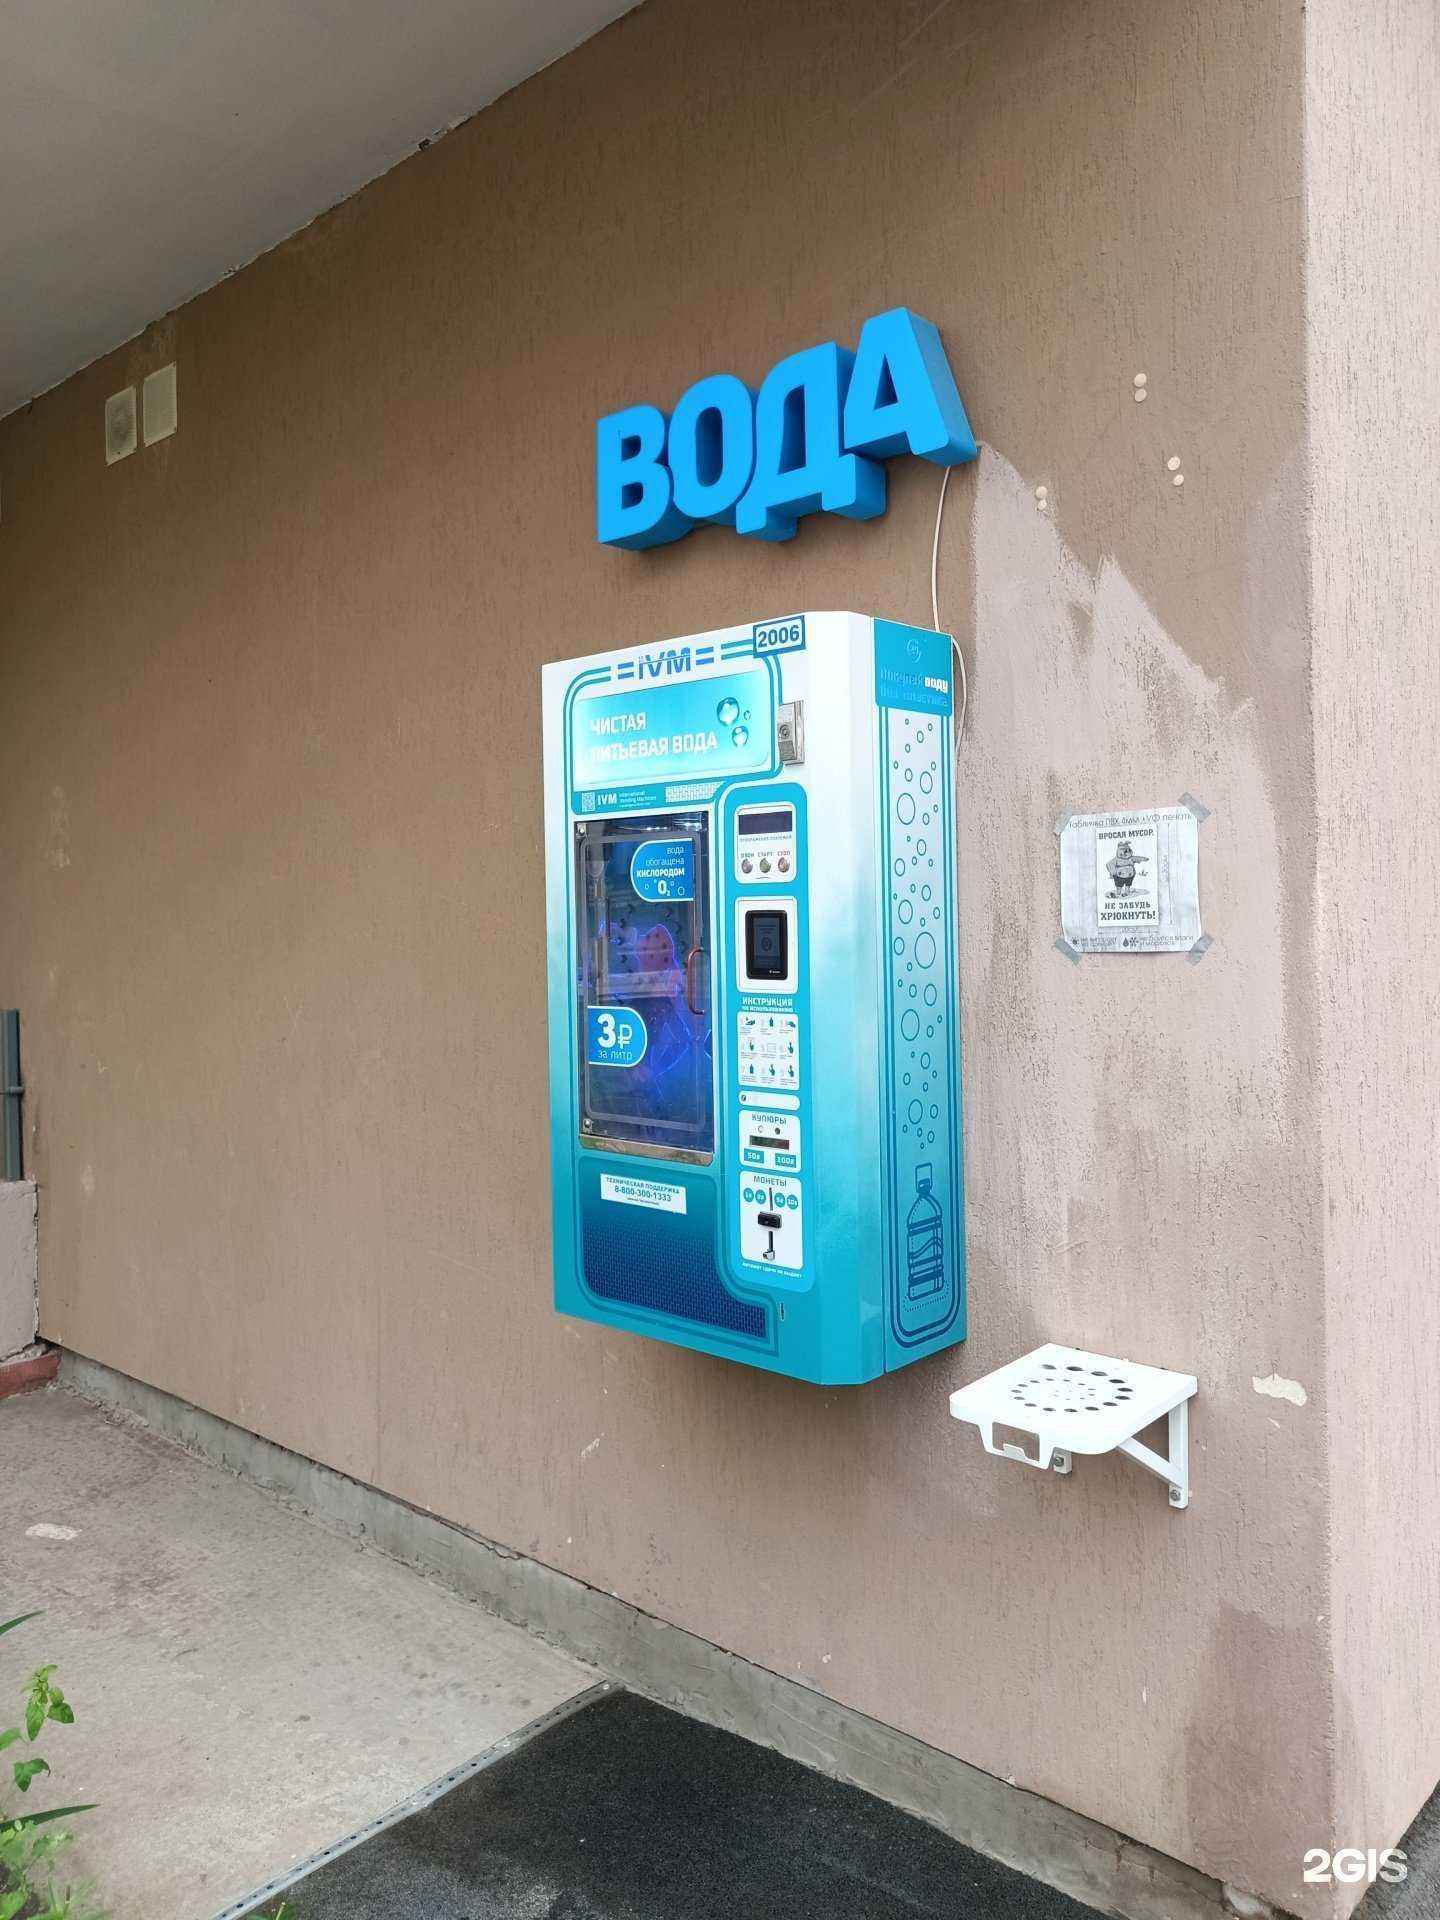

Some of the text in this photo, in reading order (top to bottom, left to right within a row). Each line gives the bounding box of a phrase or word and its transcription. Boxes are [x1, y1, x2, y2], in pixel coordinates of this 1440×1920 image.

[595, 306, 966, 541] ВОДА
[757, 624, 800, 648] 2006
[591, 712, 647, 736] ЧИСТАЯ
[592, 730, 718, 761] ПИТЬЕВАЯ ВОДА
[597, 792, 618, 806] IVM
[666, 846, 685, 855] вода
[636, 867, 685, 879] КИСЛОРОДОМ
[1104, 900, 1151, 910] НЕ ЗАБУДЬ
[1100, 910, 1157, 921] ХРЮКНУТЬ!
[742, 996, 793, 1008] ИНСТРУКЦИЯ
[598, 1051, 633, 1062] за литр
[752, 1113, 787, 1125] КУПЮРЫ
[606, 1176, 680, 1194] ТЕХНИЧЕСКАЯ ПОДДЕРЖКА
[753, 1175, 787, 1188] МОНЕТЫ
[614, 1185, 672, 1202] 8-800-300-1333
